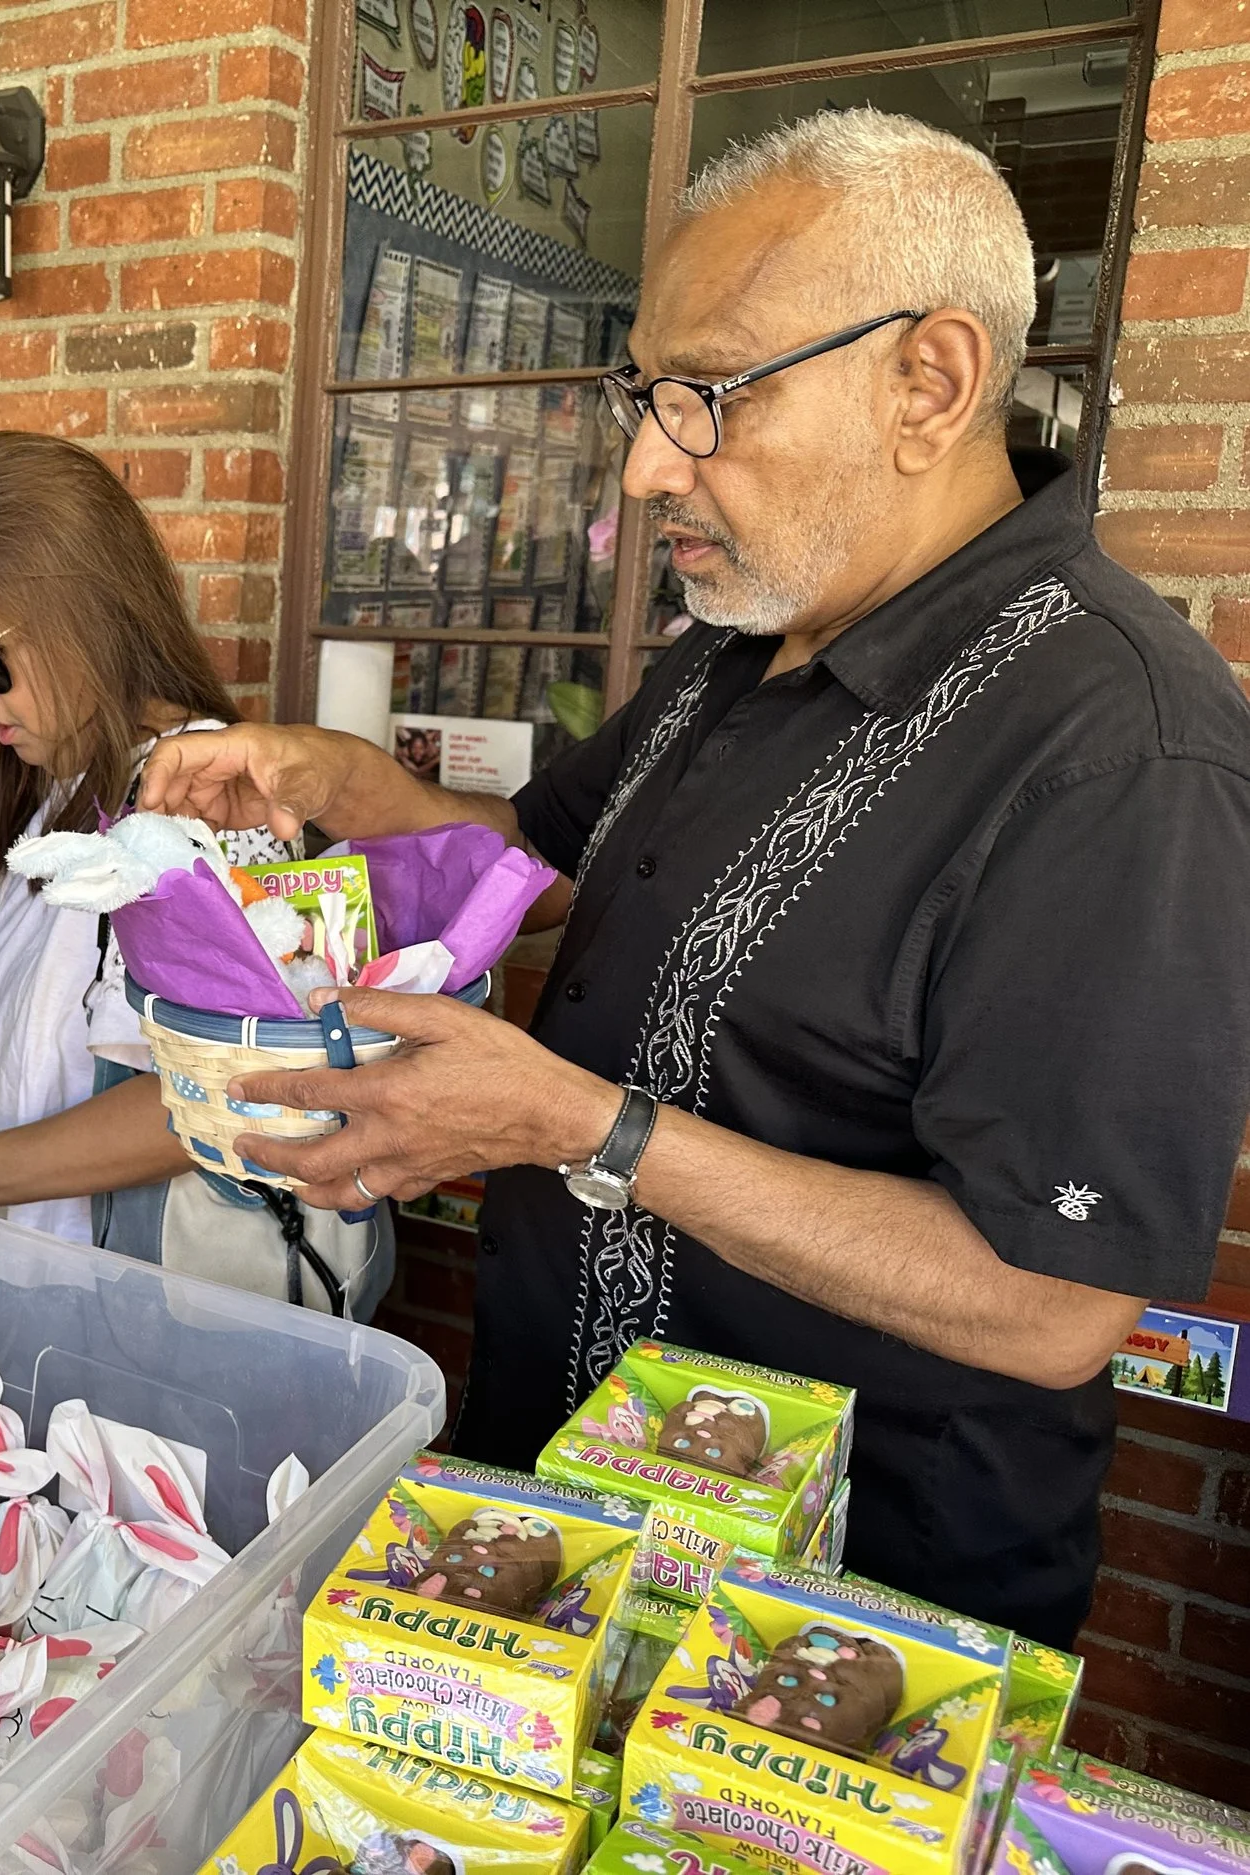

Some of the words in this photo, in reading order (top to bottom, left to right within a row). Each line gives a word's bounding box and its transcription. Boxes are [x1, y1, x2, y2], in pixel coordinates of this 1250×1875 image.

[253, 869, 344, 899] appy
[664, 1351, 755, 1379] Chocolate
[446, 1465, 542, 1496] Chocolate
[544, 1482, 594, 1500] Milk
[579, 1446, 741, 1504] Happy
[672, 1525, 720, 1560] Milk
[769, 1570, 883, 1613] Chocolate
[359, 1596, 531, 1659] Hippy
[886, 1602, 944, 1626] Milk
[356, 1667, 454, 1706] Chocolate
[384, 1651, 483, 1687] FLAVORED
[402, 1698, 455, 1721] HOLLOW
[458, 1689, 511, 1728] Milk
[348, 1697, 519, 1776] Hippy
[364, 1743, 531, 1822] Hippy
[690, 1722, 891, 1814] Hippy
[684, 1801, 800, 1855] Chocolate
[719, 1787, 836, 1841] FLAVORED
[1069, 1787, 1204, 1845] Chocolate
[736, 1840, 800, 1872] HOLLOW
[805, 1838, 870, 1875] Milk
